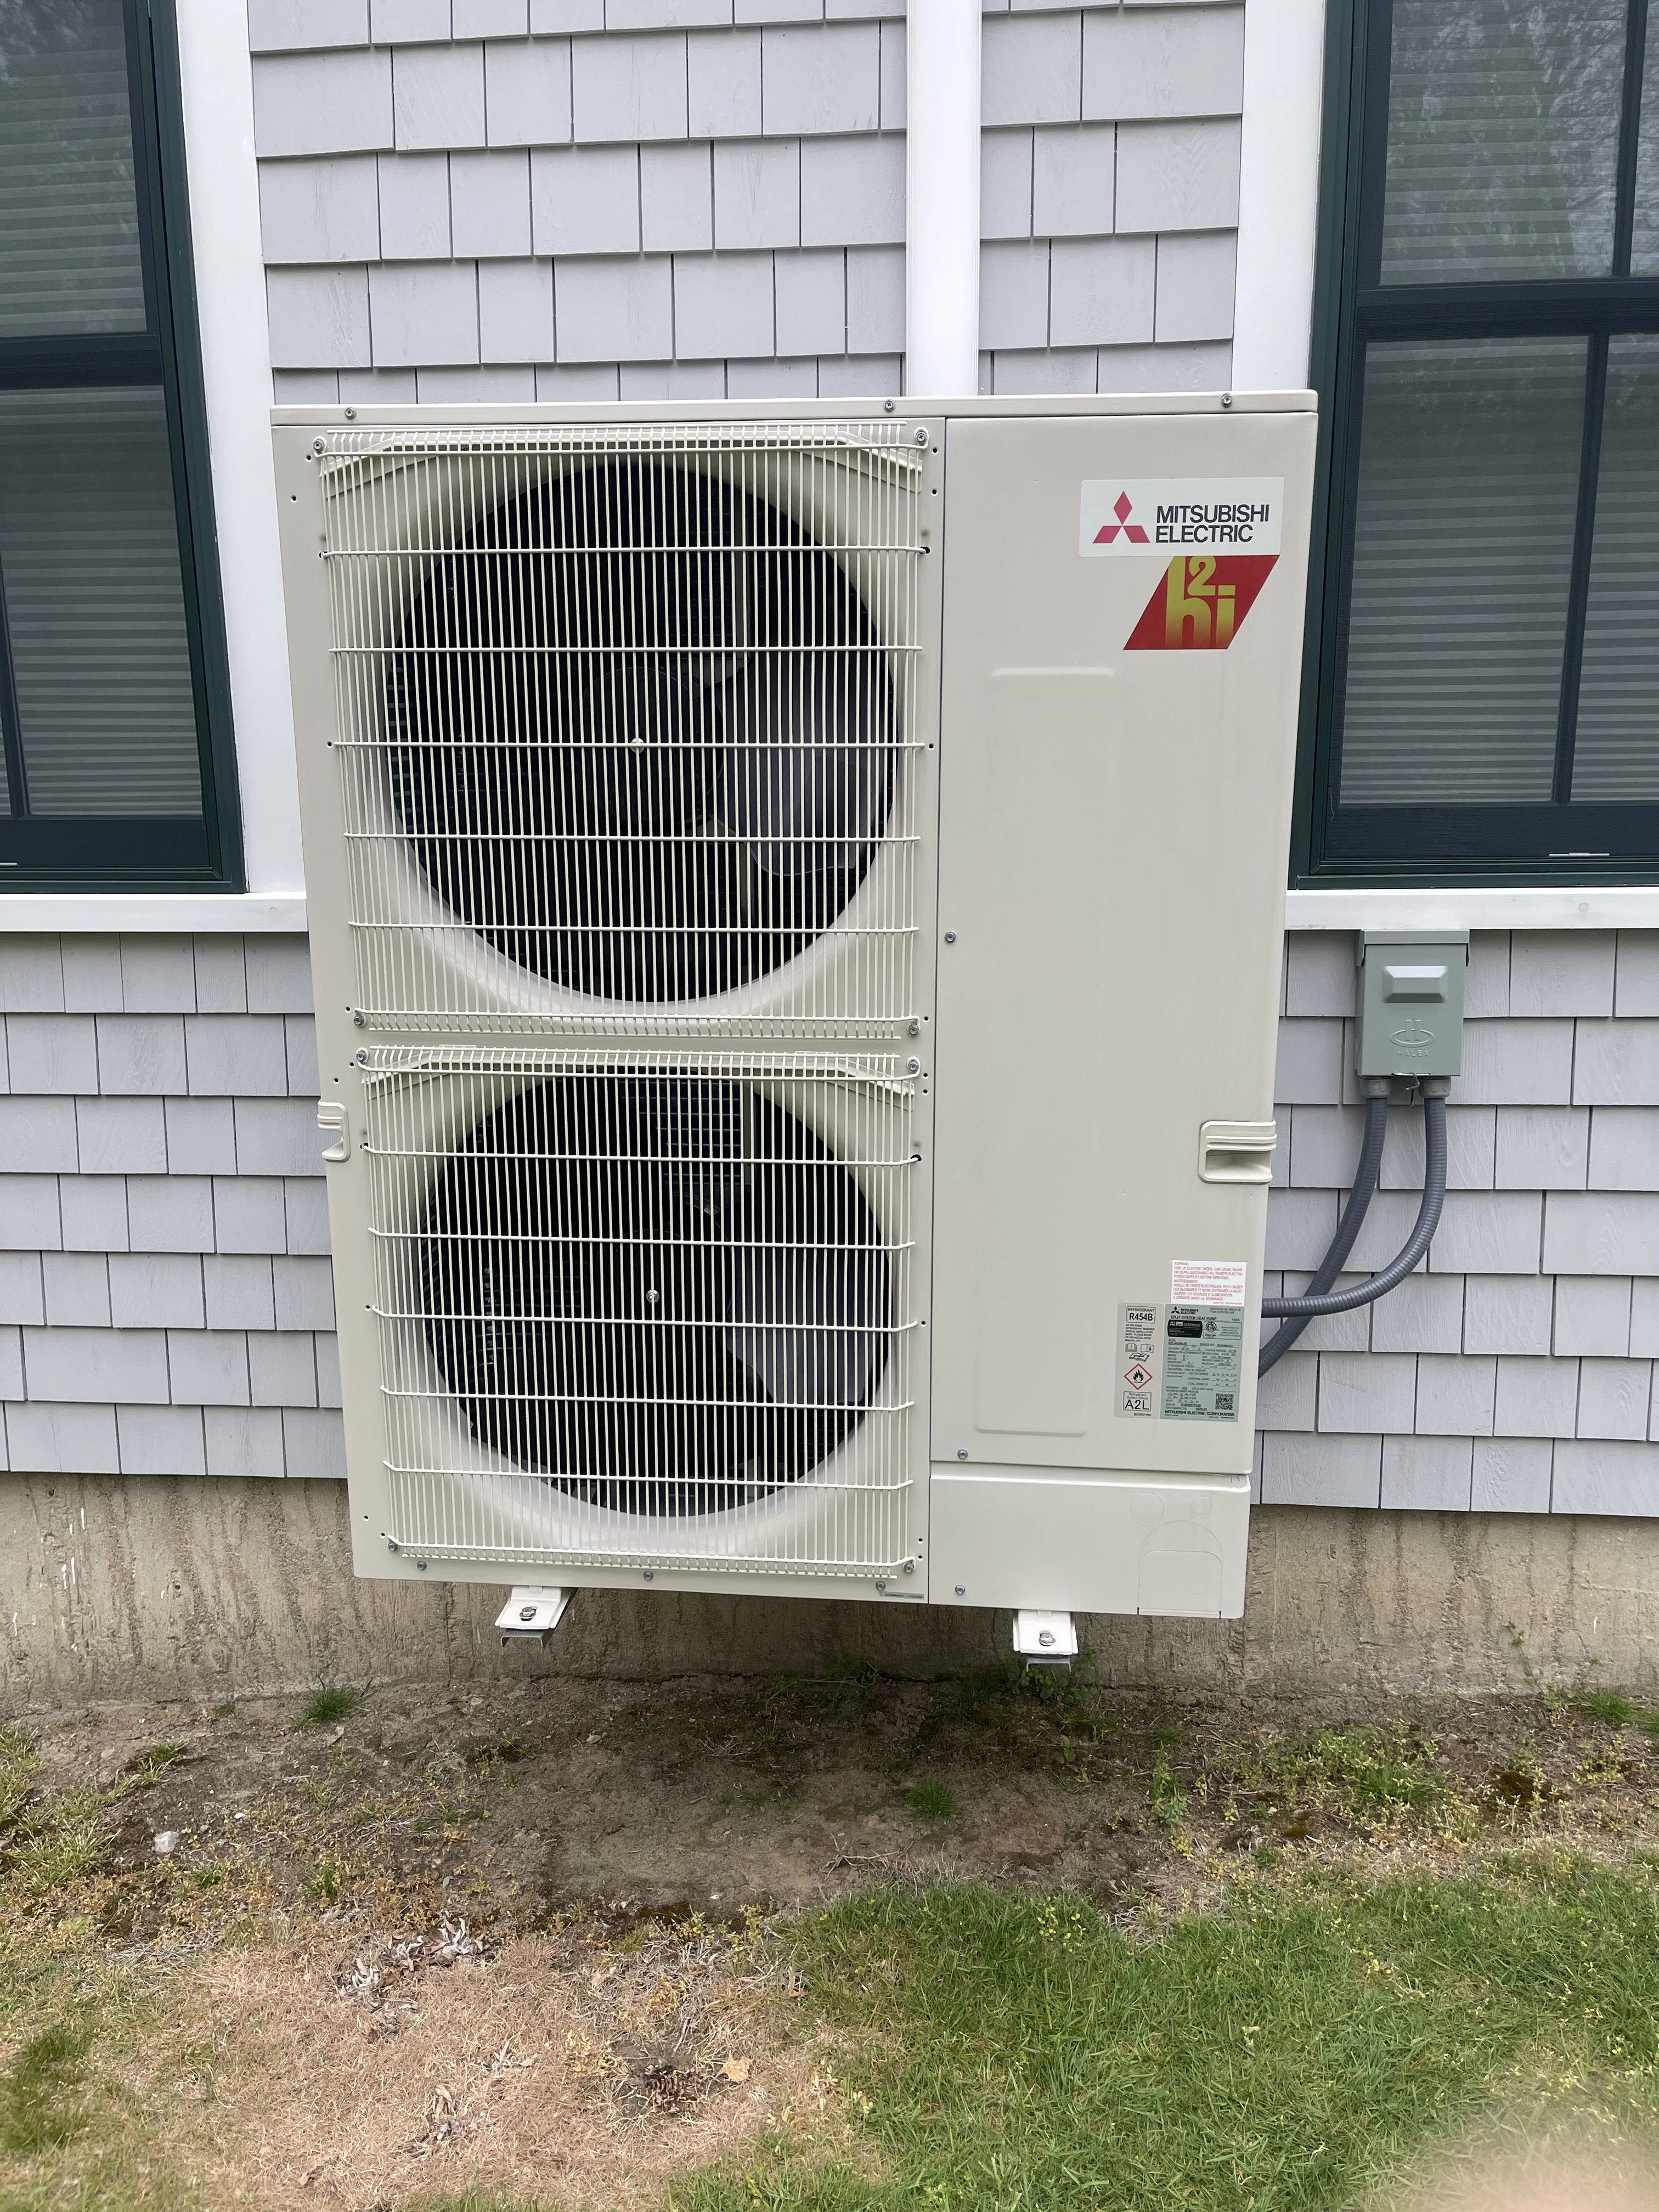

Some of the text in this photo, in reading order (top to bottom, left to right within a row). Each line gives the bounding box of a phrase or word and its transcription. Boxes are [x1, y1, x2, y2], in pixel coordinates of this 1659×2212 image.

[1156, 504, 1269, 523] MITSUBISHI
[1155, 524, 1254, 543] ELECTRIC
[1125, 1400, 1150, 1409] A2L
